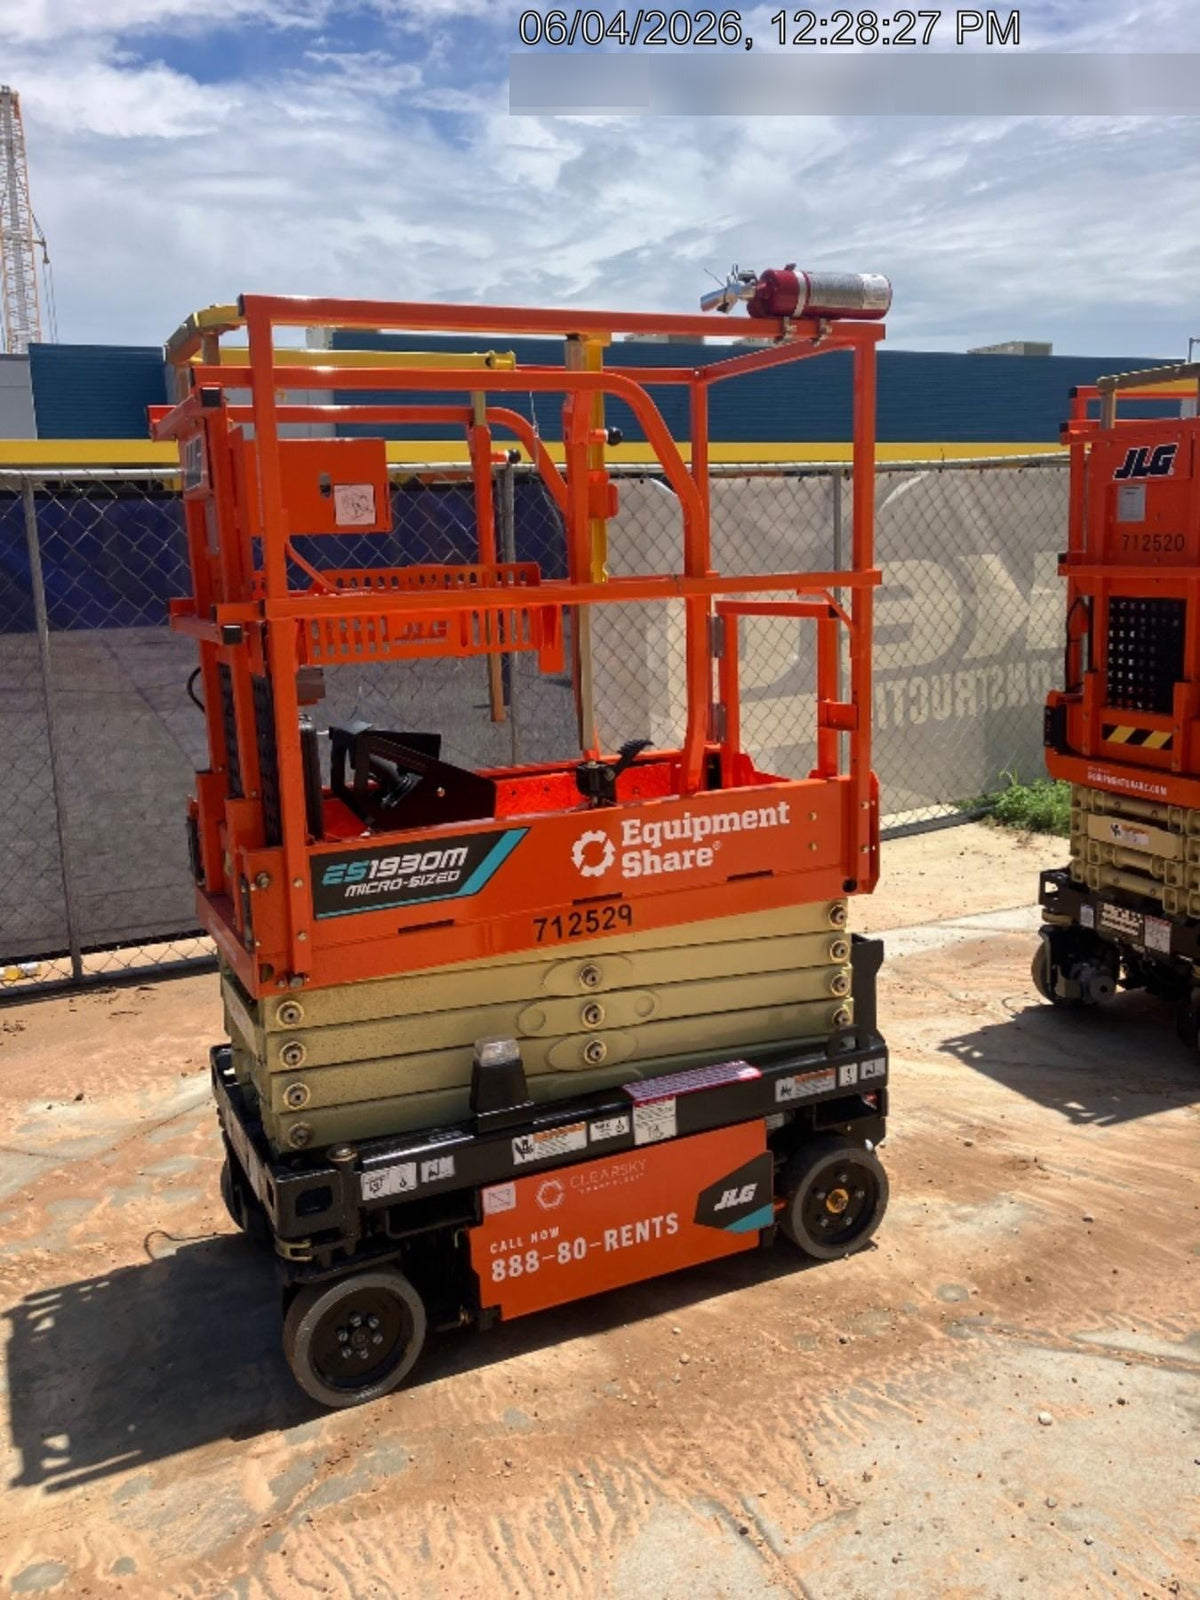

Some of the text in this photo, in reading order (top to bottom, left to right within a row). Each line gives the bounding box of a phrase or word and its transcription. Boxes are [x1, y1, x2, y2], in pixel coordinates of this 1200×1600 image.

[1112, 442, 1180, 480] JLG
[1122, 533, 1186, 553] 712520
[621, 801, 791, 848] Equipment
[322, 846, 468, 887] ES1930M
[344, 869, 461, 898] MICRO-SIZED
[532, 903, 634, 942] 712529
[569, 1158, 648, 1190] CLEARSKY
[713, 1182, 759, 1212] JLG
[489, 1226, 561, 1255] CALL NOW
[490, 1212, 680, 1283] 888-80-RENTS
